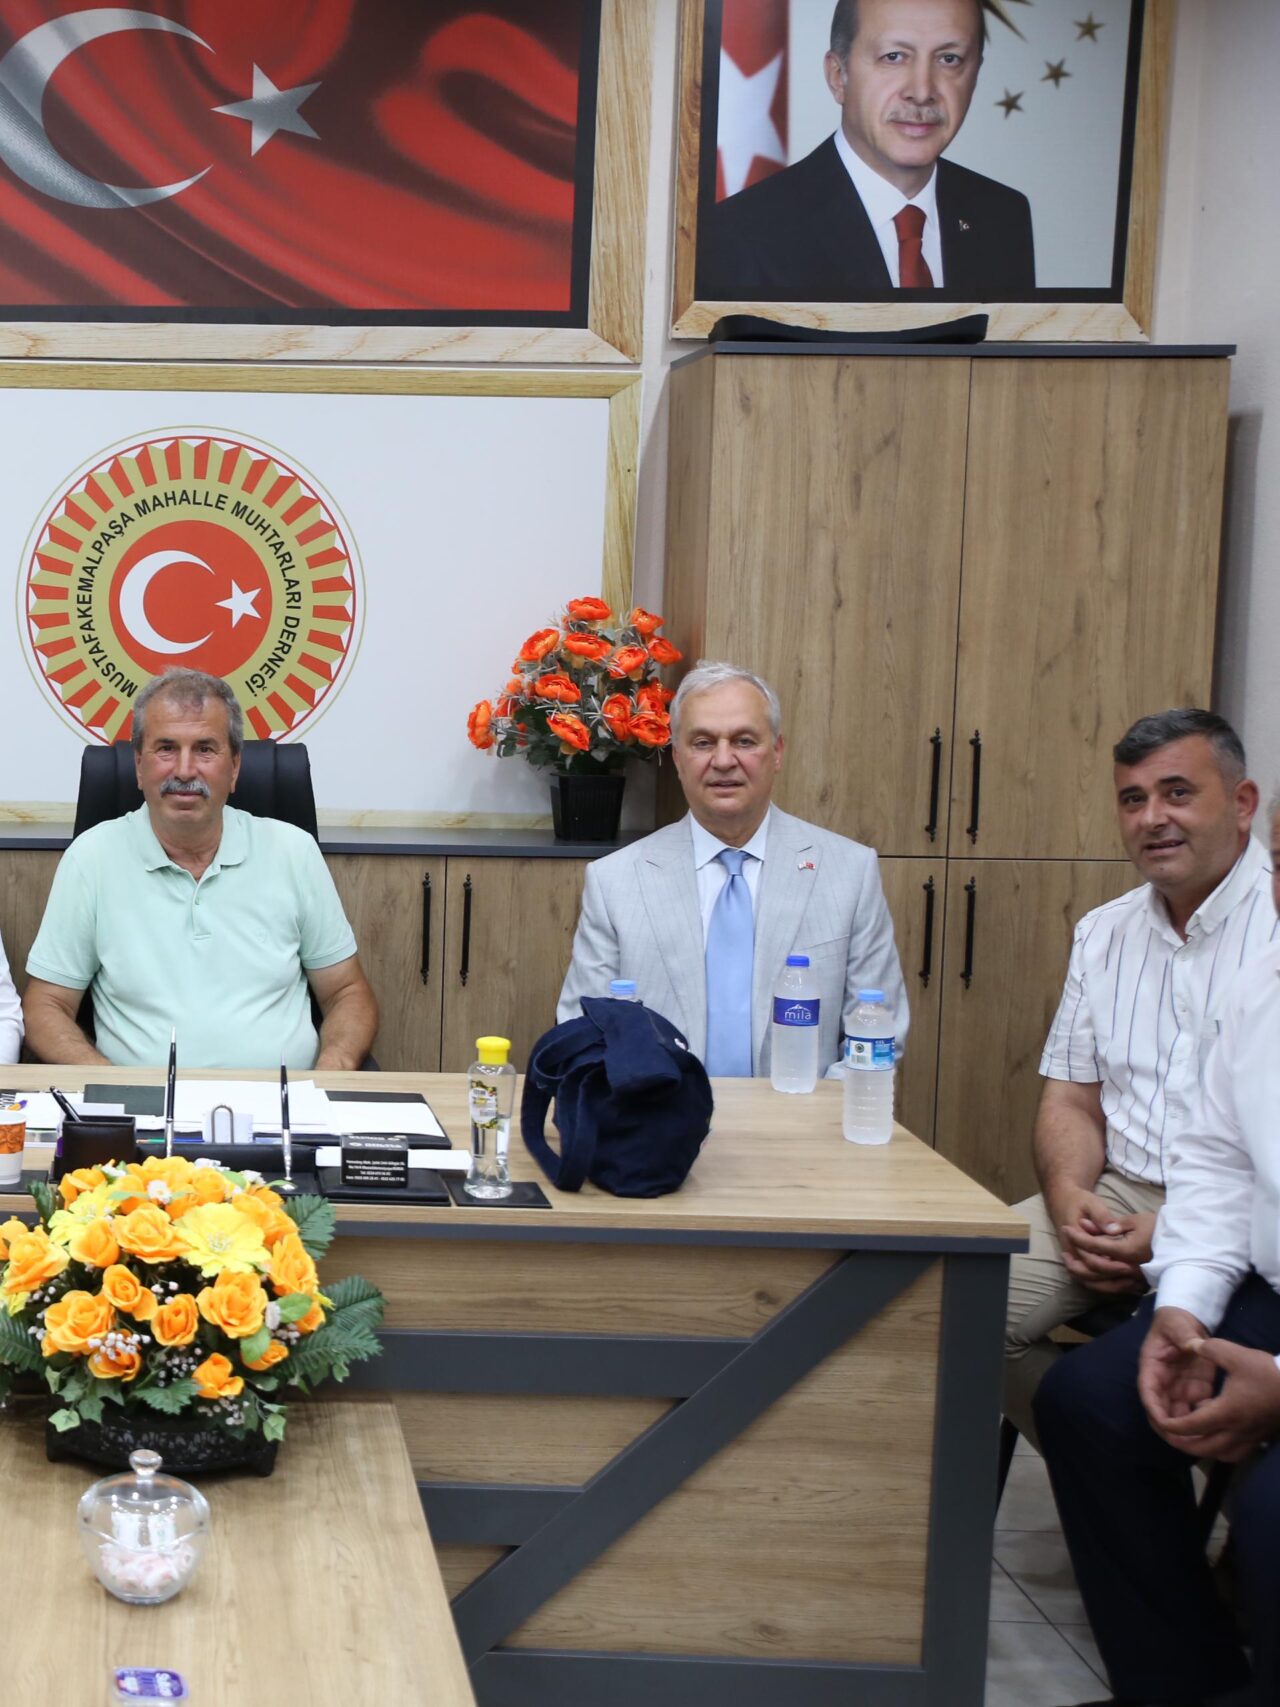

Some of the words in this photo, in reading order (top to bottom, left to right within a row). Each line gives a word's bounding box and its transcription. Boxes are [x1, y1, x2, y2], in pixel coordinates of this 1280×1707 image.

[134, 489, 229, 516] MAHALLE
[230, 501, 301, 610] MUHTARLARI
[76, 513, 138, 698] MUSTAFAKEMALPAŞA
[245, 616, 300, 697] DERNEĞİ
[785, 1010, 811, 1019] mila
